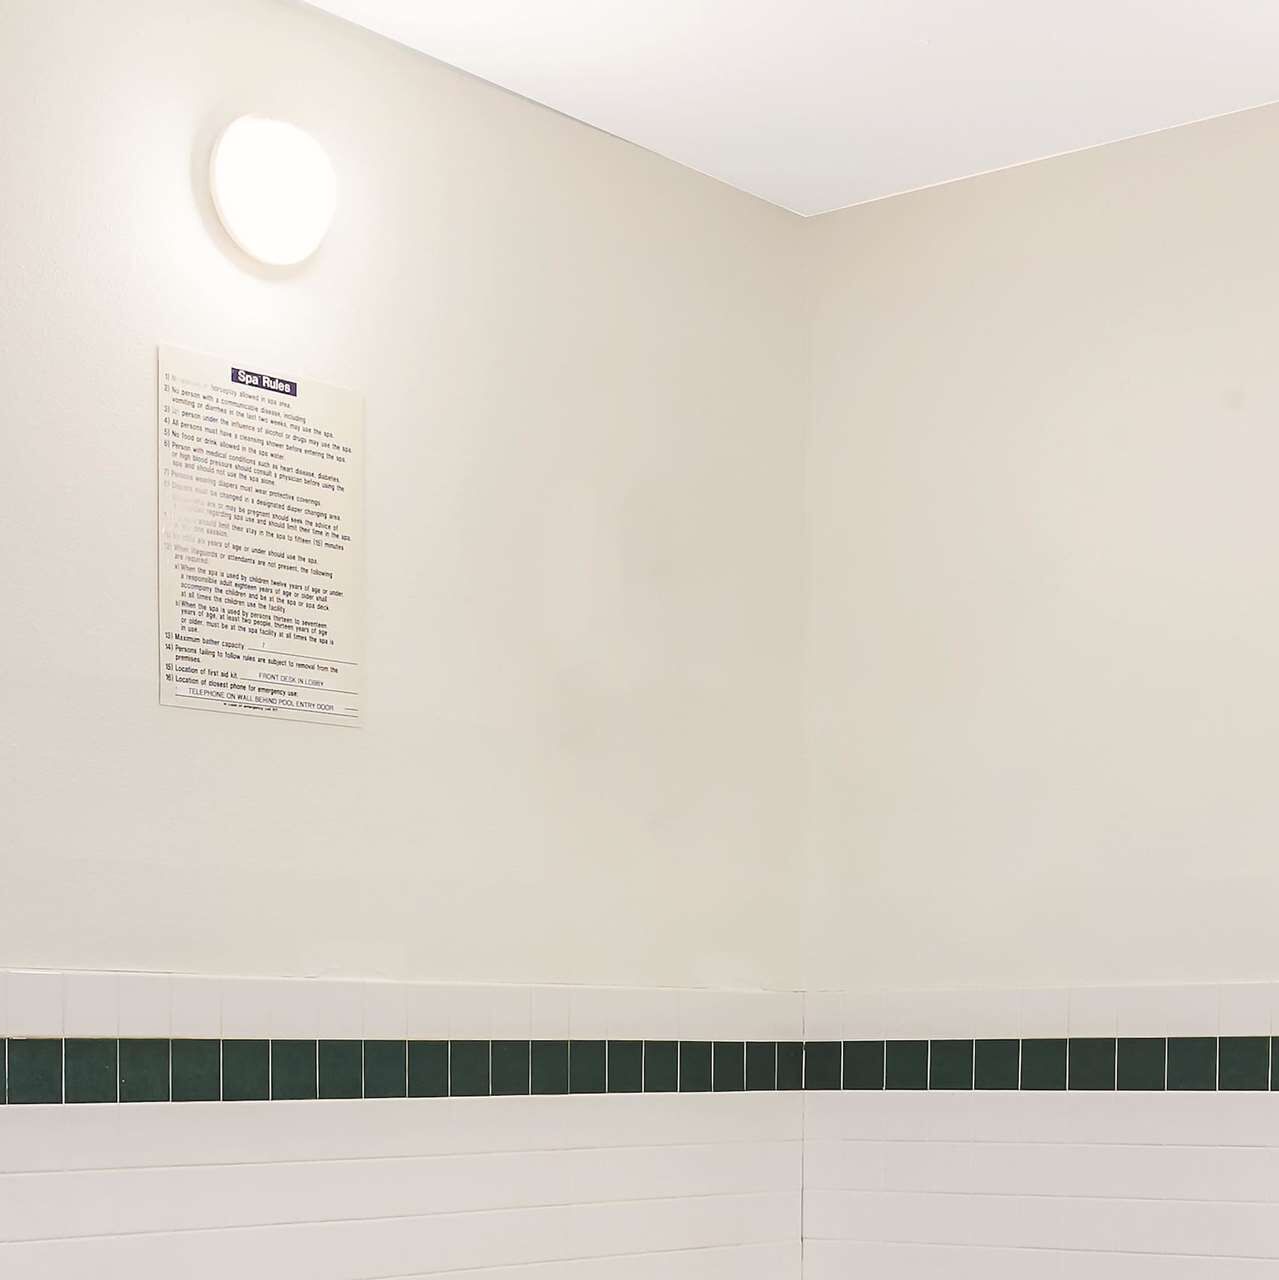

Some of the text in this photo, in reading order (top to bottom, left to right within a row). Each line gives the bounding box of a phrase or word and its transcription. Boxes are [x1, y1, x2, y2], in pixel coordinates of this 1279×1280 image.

[238, 370, 291, 393] Spa Rules
[258, 671, 278, 680] FRONT
[279, 674, 296, 682] DESK
[304, 678, 323, 686] LOBBY
[188, 687, 224, 697] TELEPHONE
[254, 695, 277, 703] BEHIND
[278, 698, 294, 706] POOL
[295, 700, 315, 708] ENTRY
